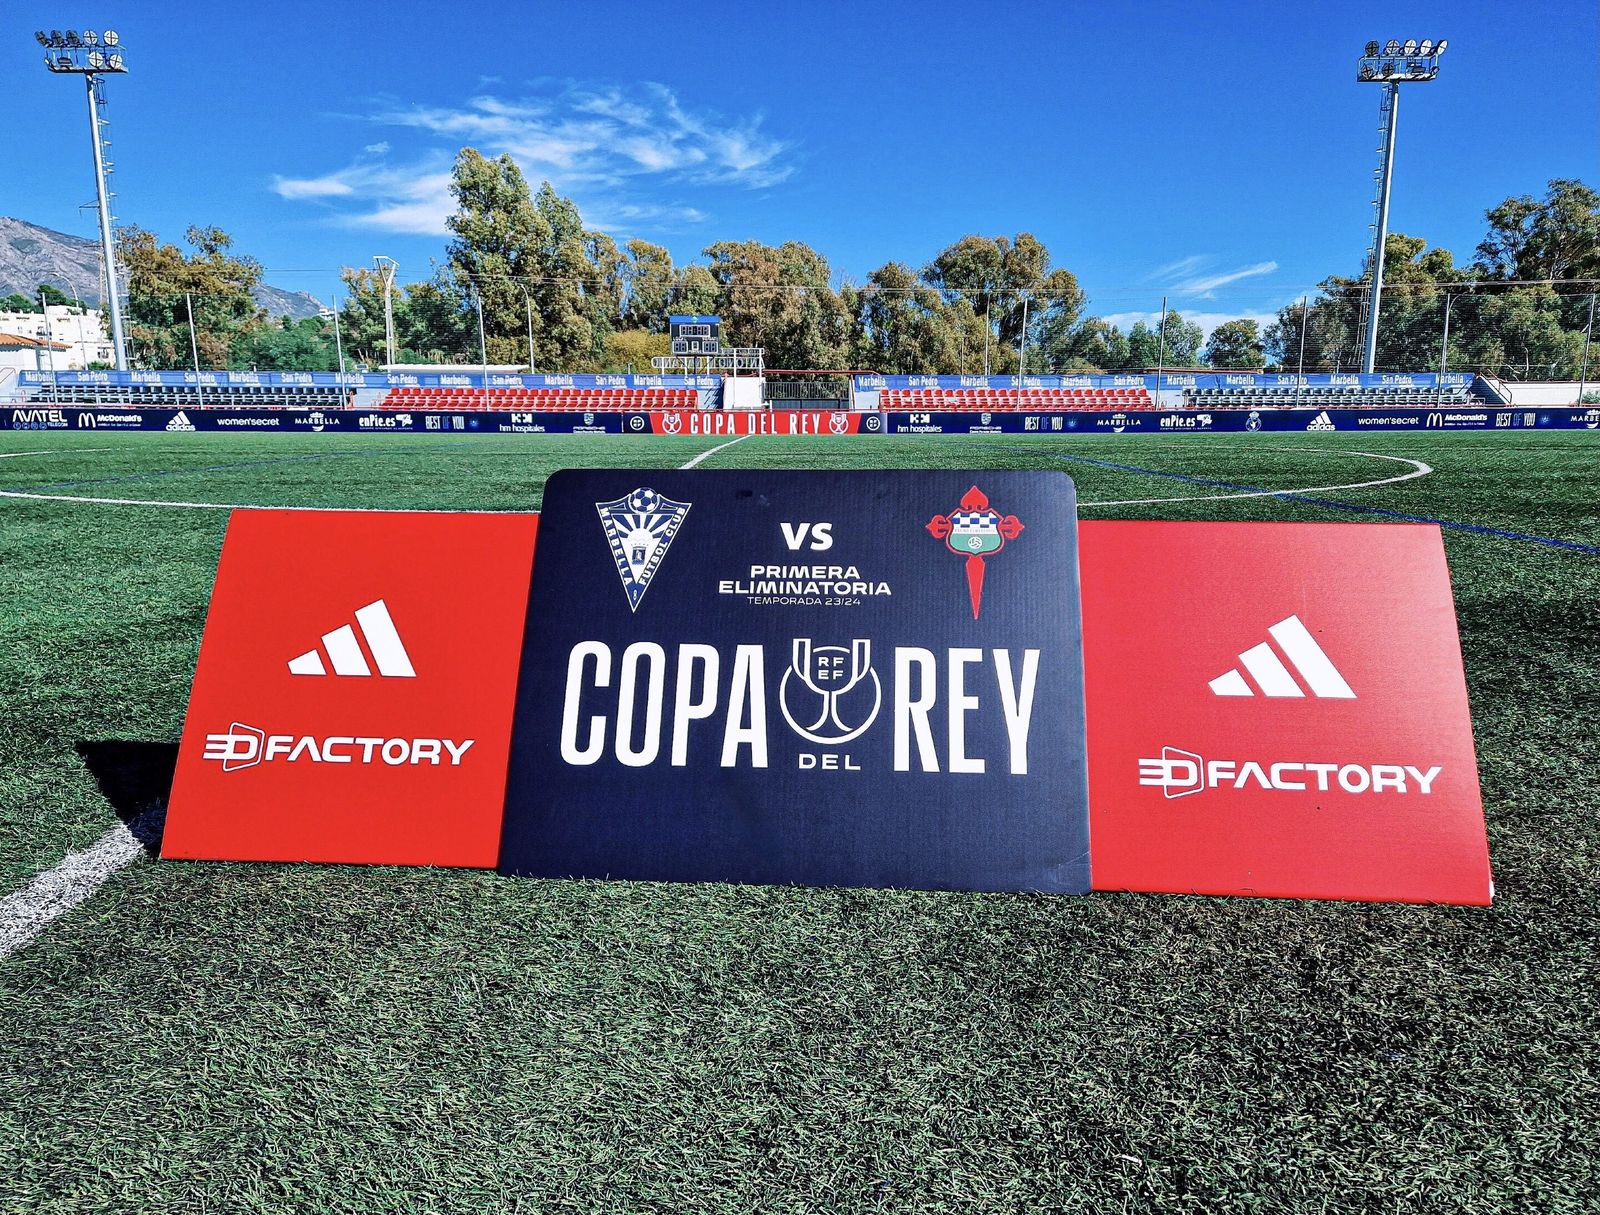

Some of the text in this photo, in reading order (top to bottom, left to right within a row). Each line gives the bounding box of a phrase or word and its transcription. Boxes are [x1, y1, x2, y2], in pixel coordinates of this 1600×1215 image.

[335, 372, 364, 383] Mrbella
[12, 410, 68, 422] AVATEL
[97, 414, 142, 422] McDonald's
[217, 418, 279, 426] women'secret
[359, 414, 396, 427] enPie.es
[1160, 415, 1196, 427] enPie.es
[1358, 417, 1419, 425] women'secret
[1496, 413, 1512, 427] BEST
[1523, 413, 1536, 426] YOU
[166, 424, 196, 432] adidas
[425, 416, 440, 430] BEST
[452, 416, 465, 430] YOU
[499, 424, 545, 433] hm hospitales
[690, 413, 820, 434] COPA DEL REY
[910, 425, 942, 434] hospitales
[1024, 416, 1040, 430] BEST
[1051, 416, 1063, 430] YOU
[780, 522, 833, 550] VS
[600, 507, 633, 586] MARBELLA
[638, 508, 686, 586] FUTBOL CLUB
[750, 565, 860, 579] PRIMERA
[718, 580, 892, 595] ELIMINATORIA
[747, 596, 861, 606] TEMPORADA 23/24
[560, 640, 1040, 775] COPA REY
[798, 754, 861, 770] DEL
